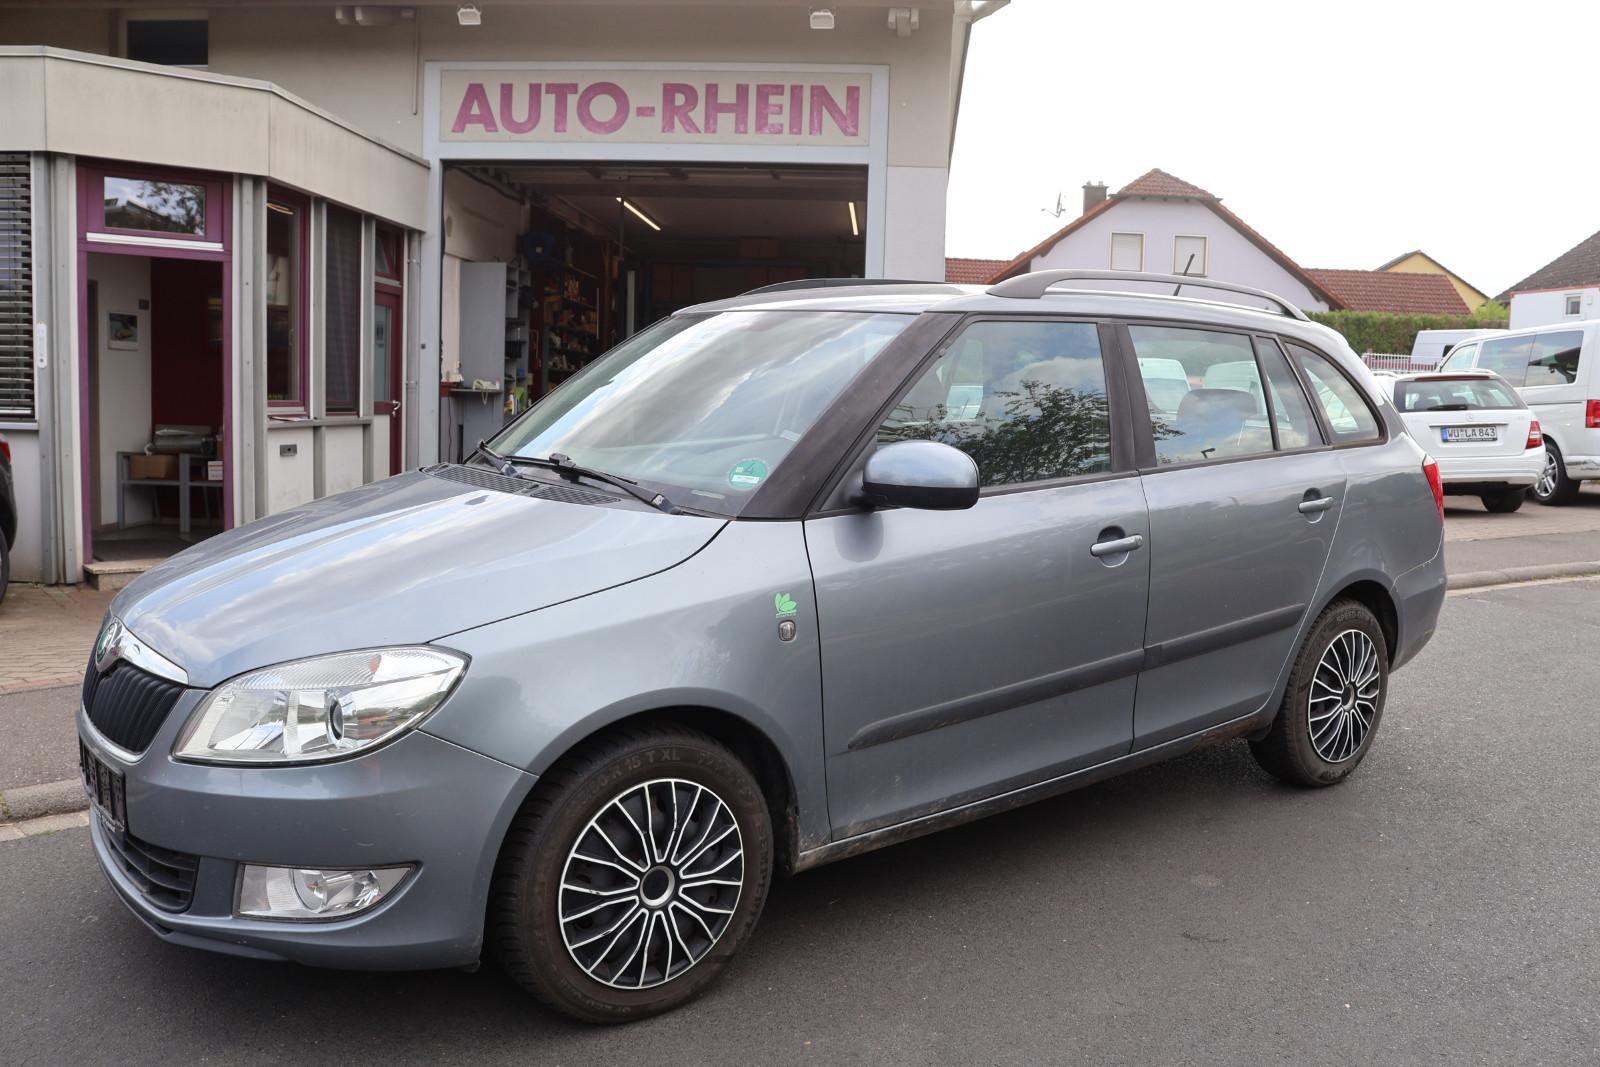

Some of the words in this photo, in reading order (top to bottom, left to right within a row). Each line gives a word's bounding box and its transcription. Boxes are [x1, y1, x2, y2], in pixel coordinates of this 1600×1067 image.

[451, 82, 860, 137] AUTO-RHEIN
[1478, 428, 1496, 437] 843
[645, 750, 655, 763] T
[661, 747, 680, 761] XL
